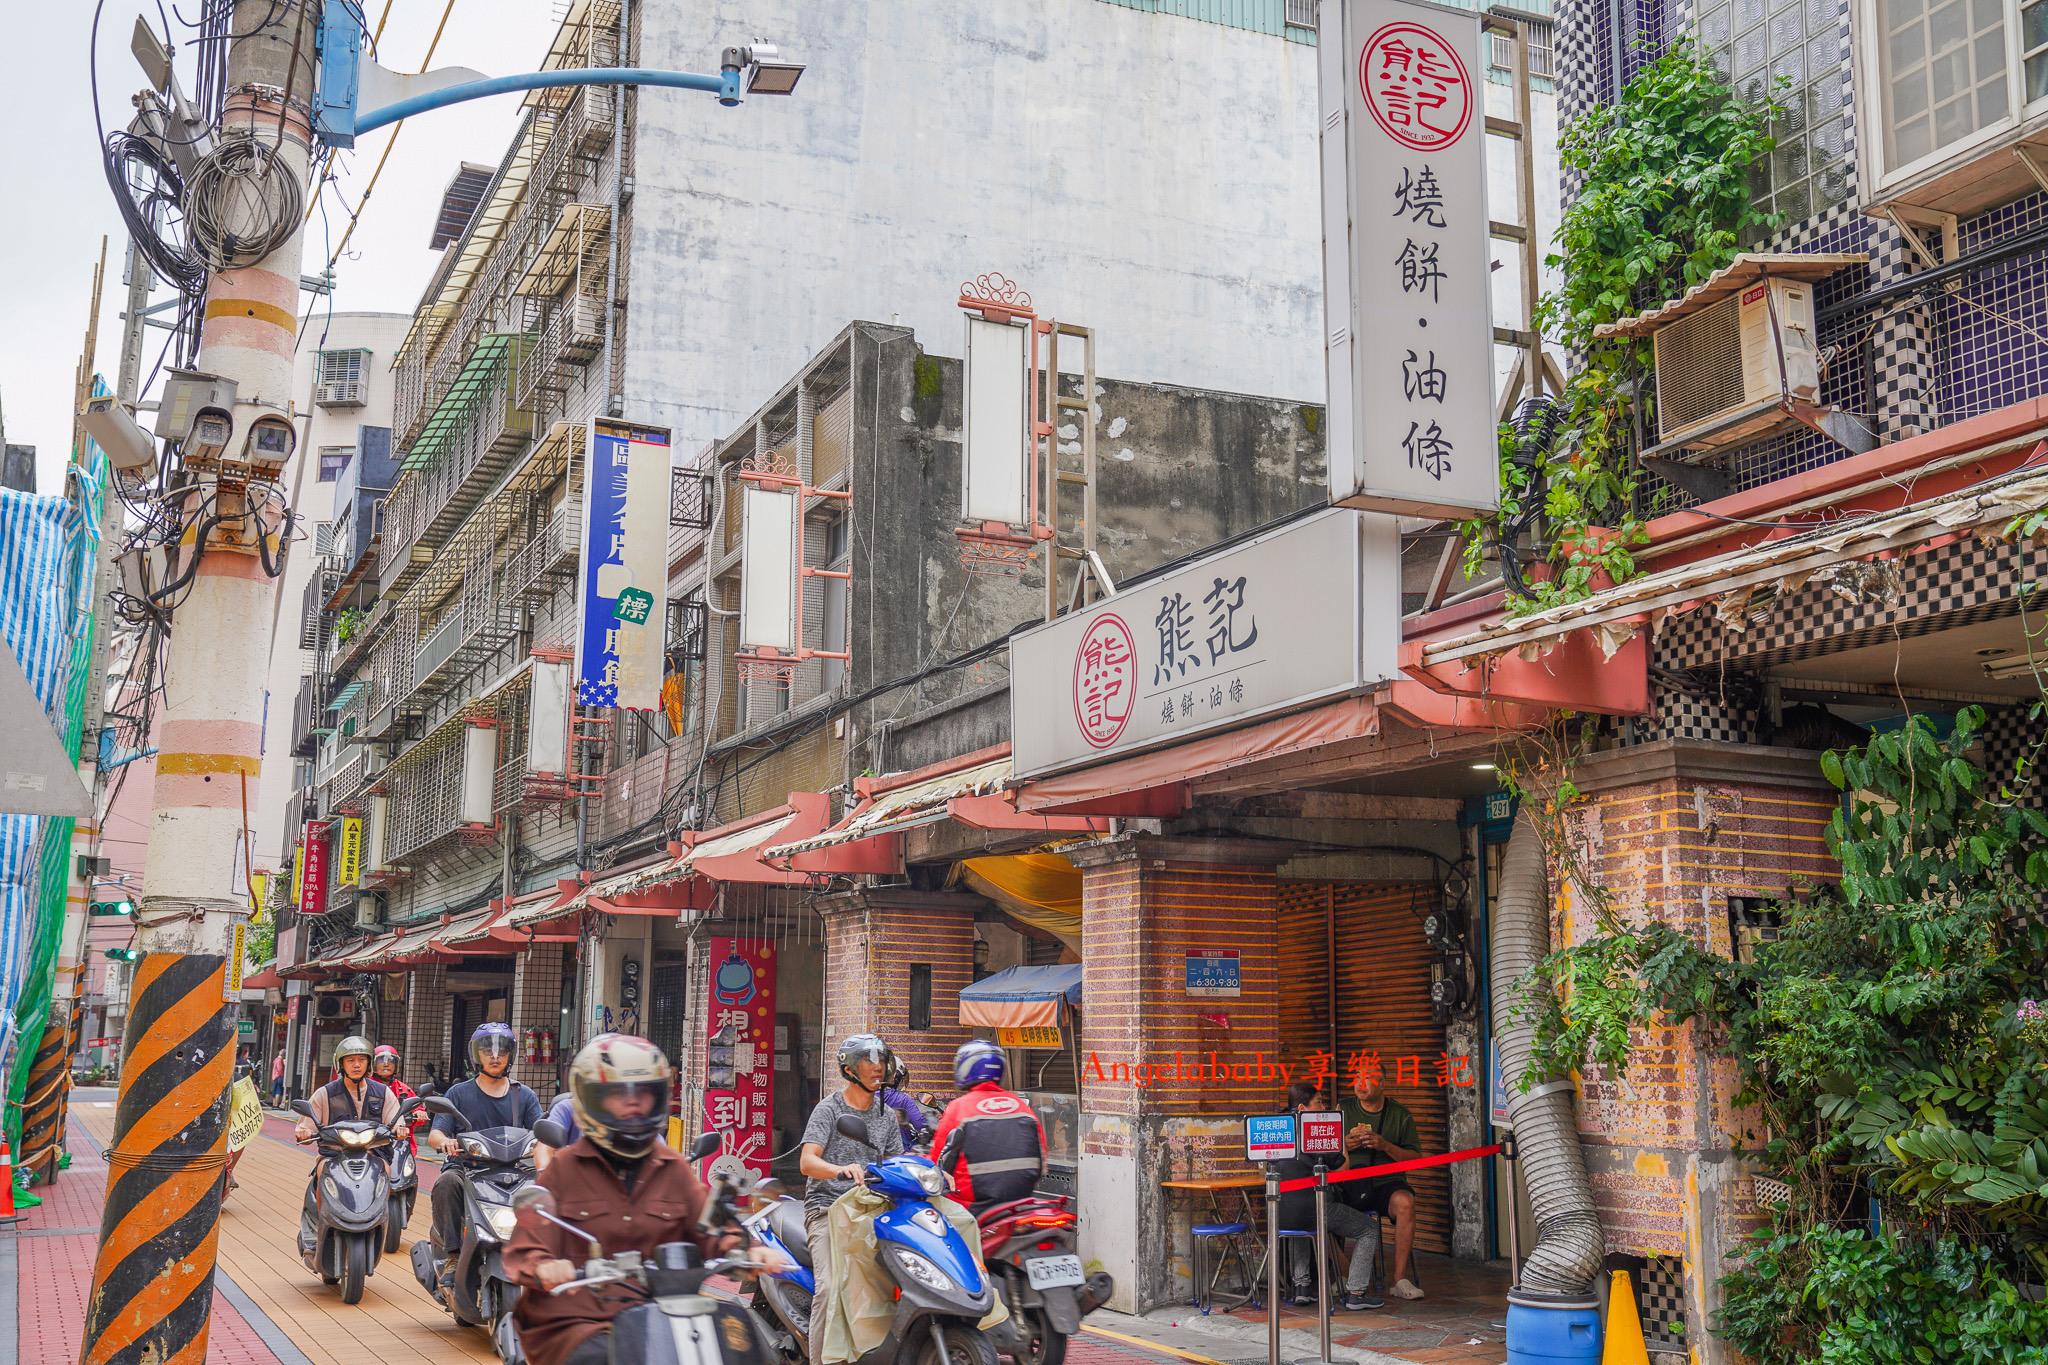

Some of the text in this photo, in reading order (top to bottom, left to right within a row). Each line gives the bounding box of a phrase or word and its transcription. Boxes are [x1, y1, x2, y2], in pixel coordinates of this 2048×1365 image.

[1380, 38, 1460, 138] 熊記
[1400, 127, 1419, 140] SINCE
[1153, 576, 1258, 687] 熊記
[1083, 636, 1131, 728] 熊記
[1493, 802, 1507, 817] 291
[345, 832, 358, 881] 東元家電製品
[232, 927, 246, 989] 251433
[1005, 1031, 1015, 1045] 45
[750, 1053, 769, 1147] 選物販賣機
[1256, 1119, 1288, 1131] 防疫期間
[1310, 1125, 1335, 1137] 請在此
[1253, 1131, 1292, 1143] 不提供內用
[1306, 1137, 1339, 1151] 排隊點餐
